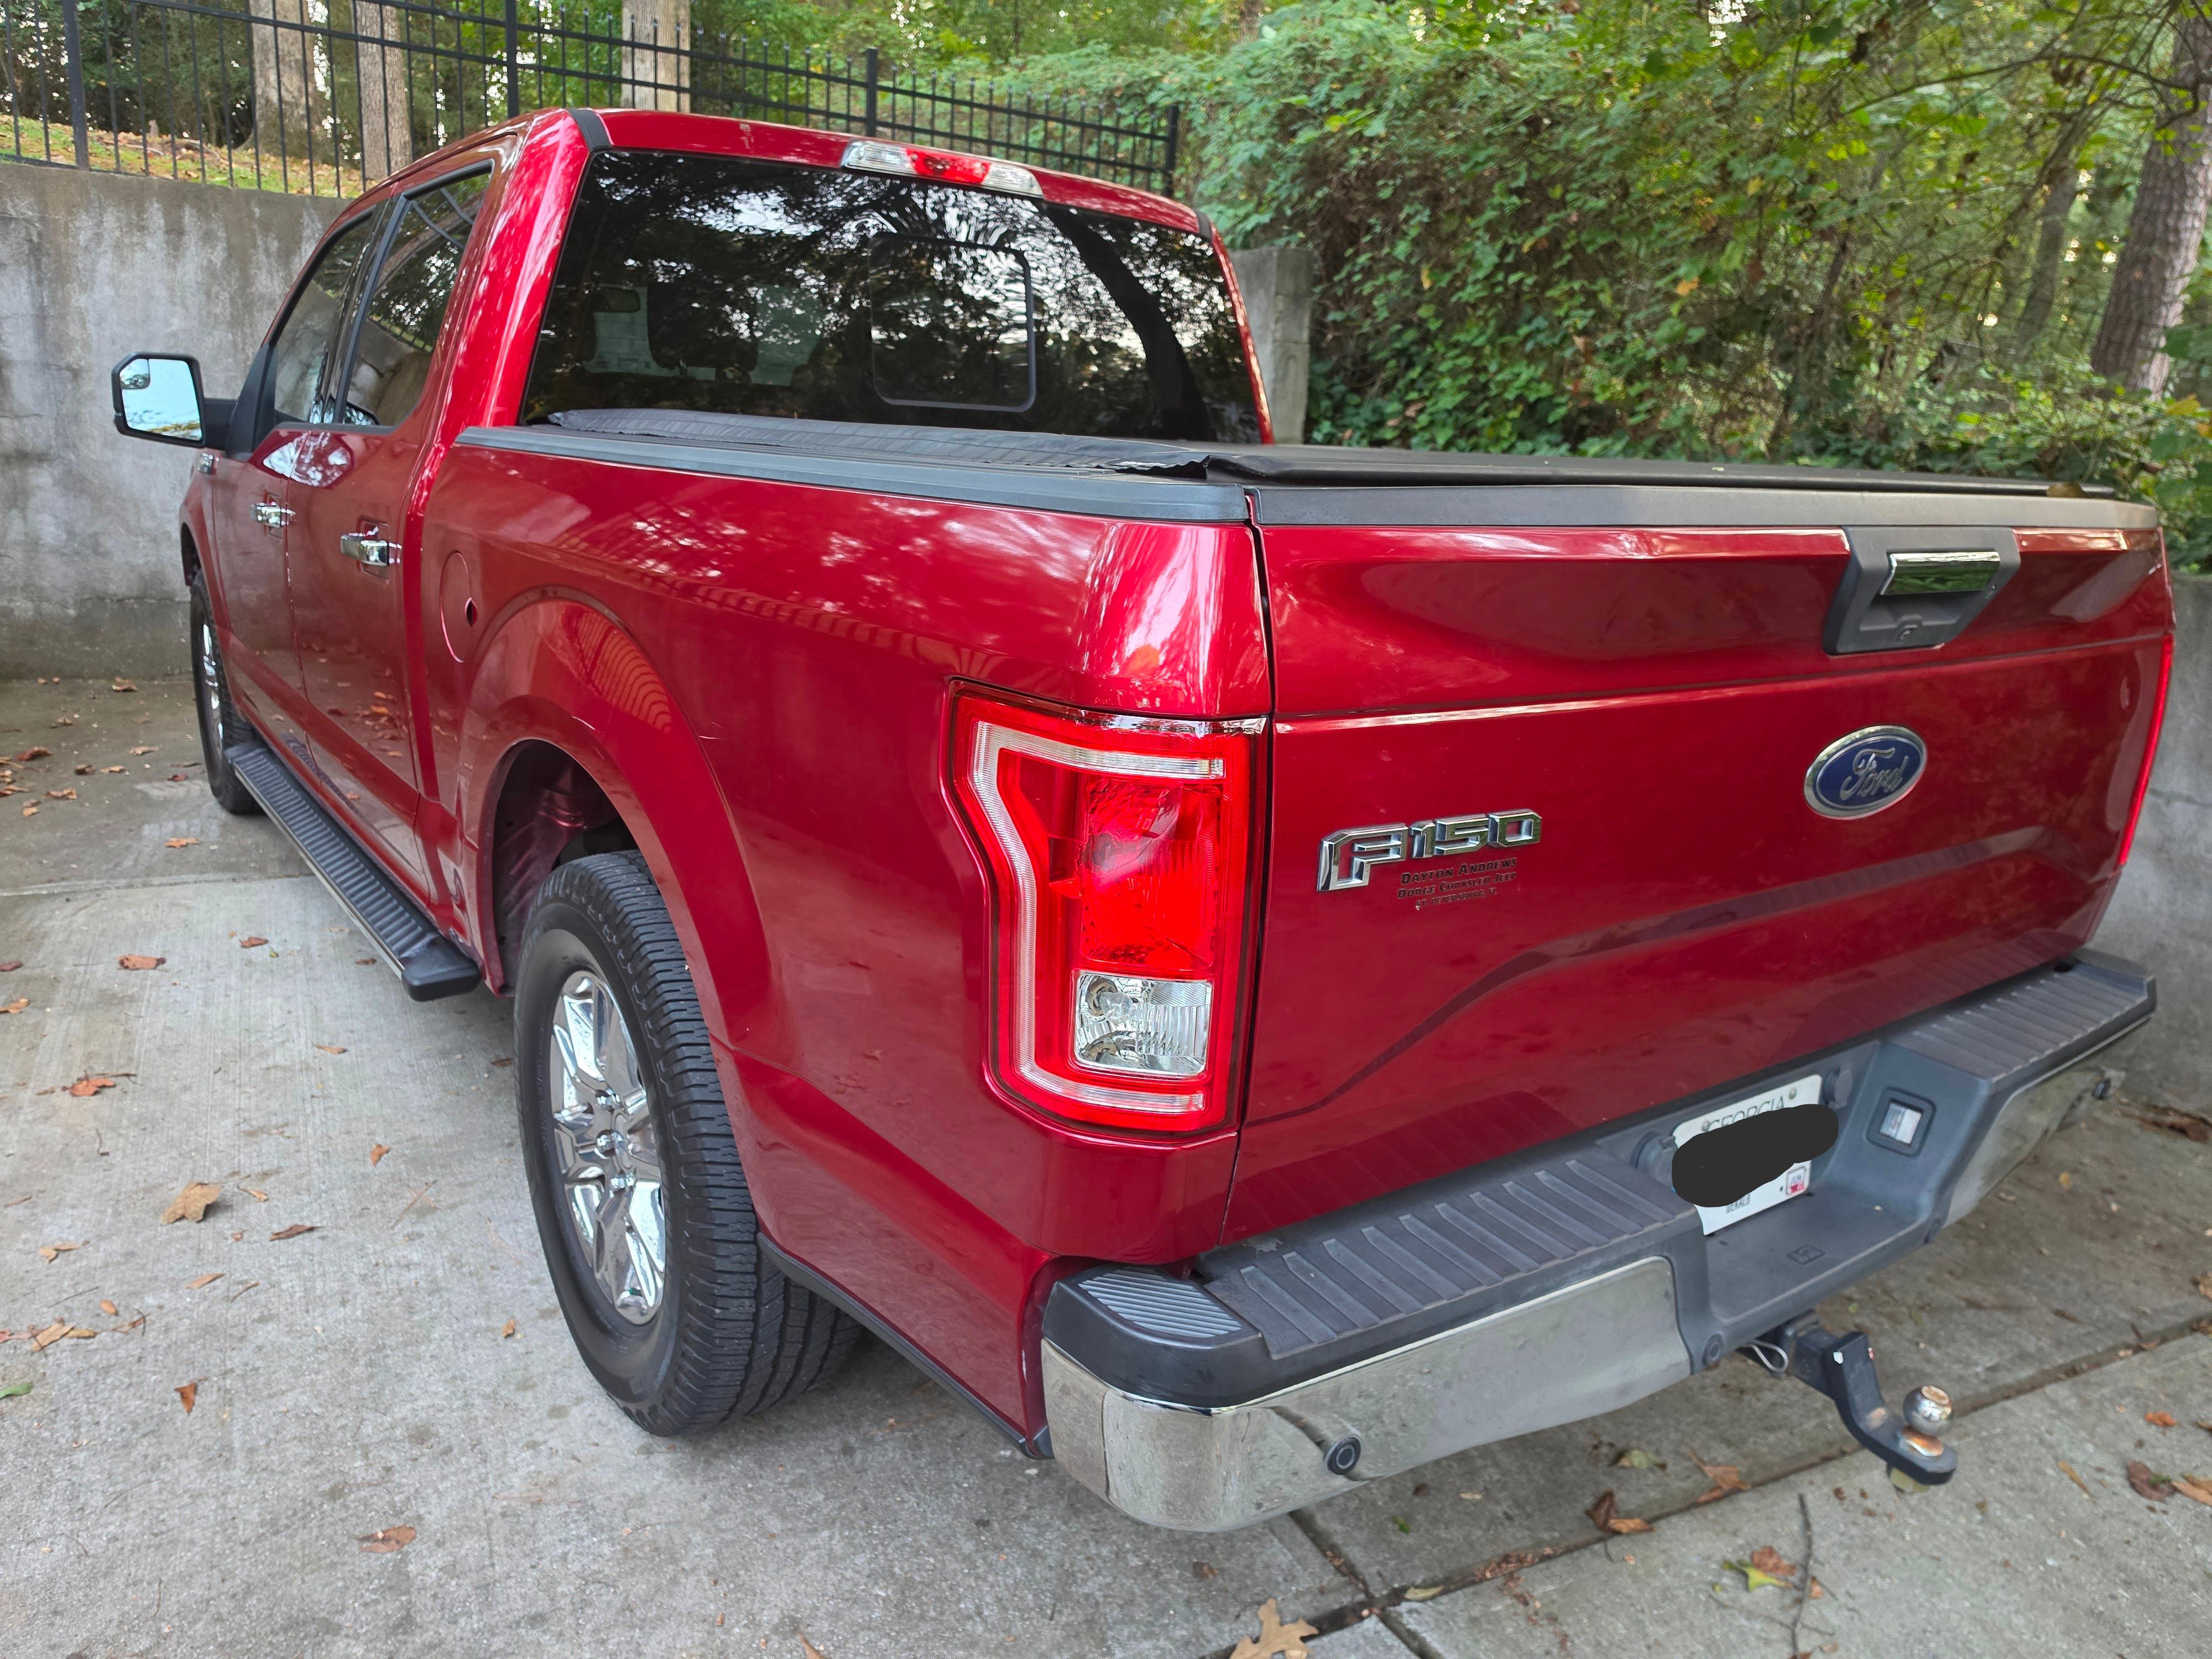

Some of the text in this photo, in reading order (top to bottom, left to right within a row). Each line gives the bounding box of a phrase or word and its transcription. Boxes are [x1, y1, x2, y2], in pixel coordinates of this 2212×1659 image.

[1839, 747, 1909, 801] Ford
[1401, 858, 1517, 884] DAYTON ANDREWS
[1397, 872, 1517, 899] DODGE CHRYSLER JEEP
